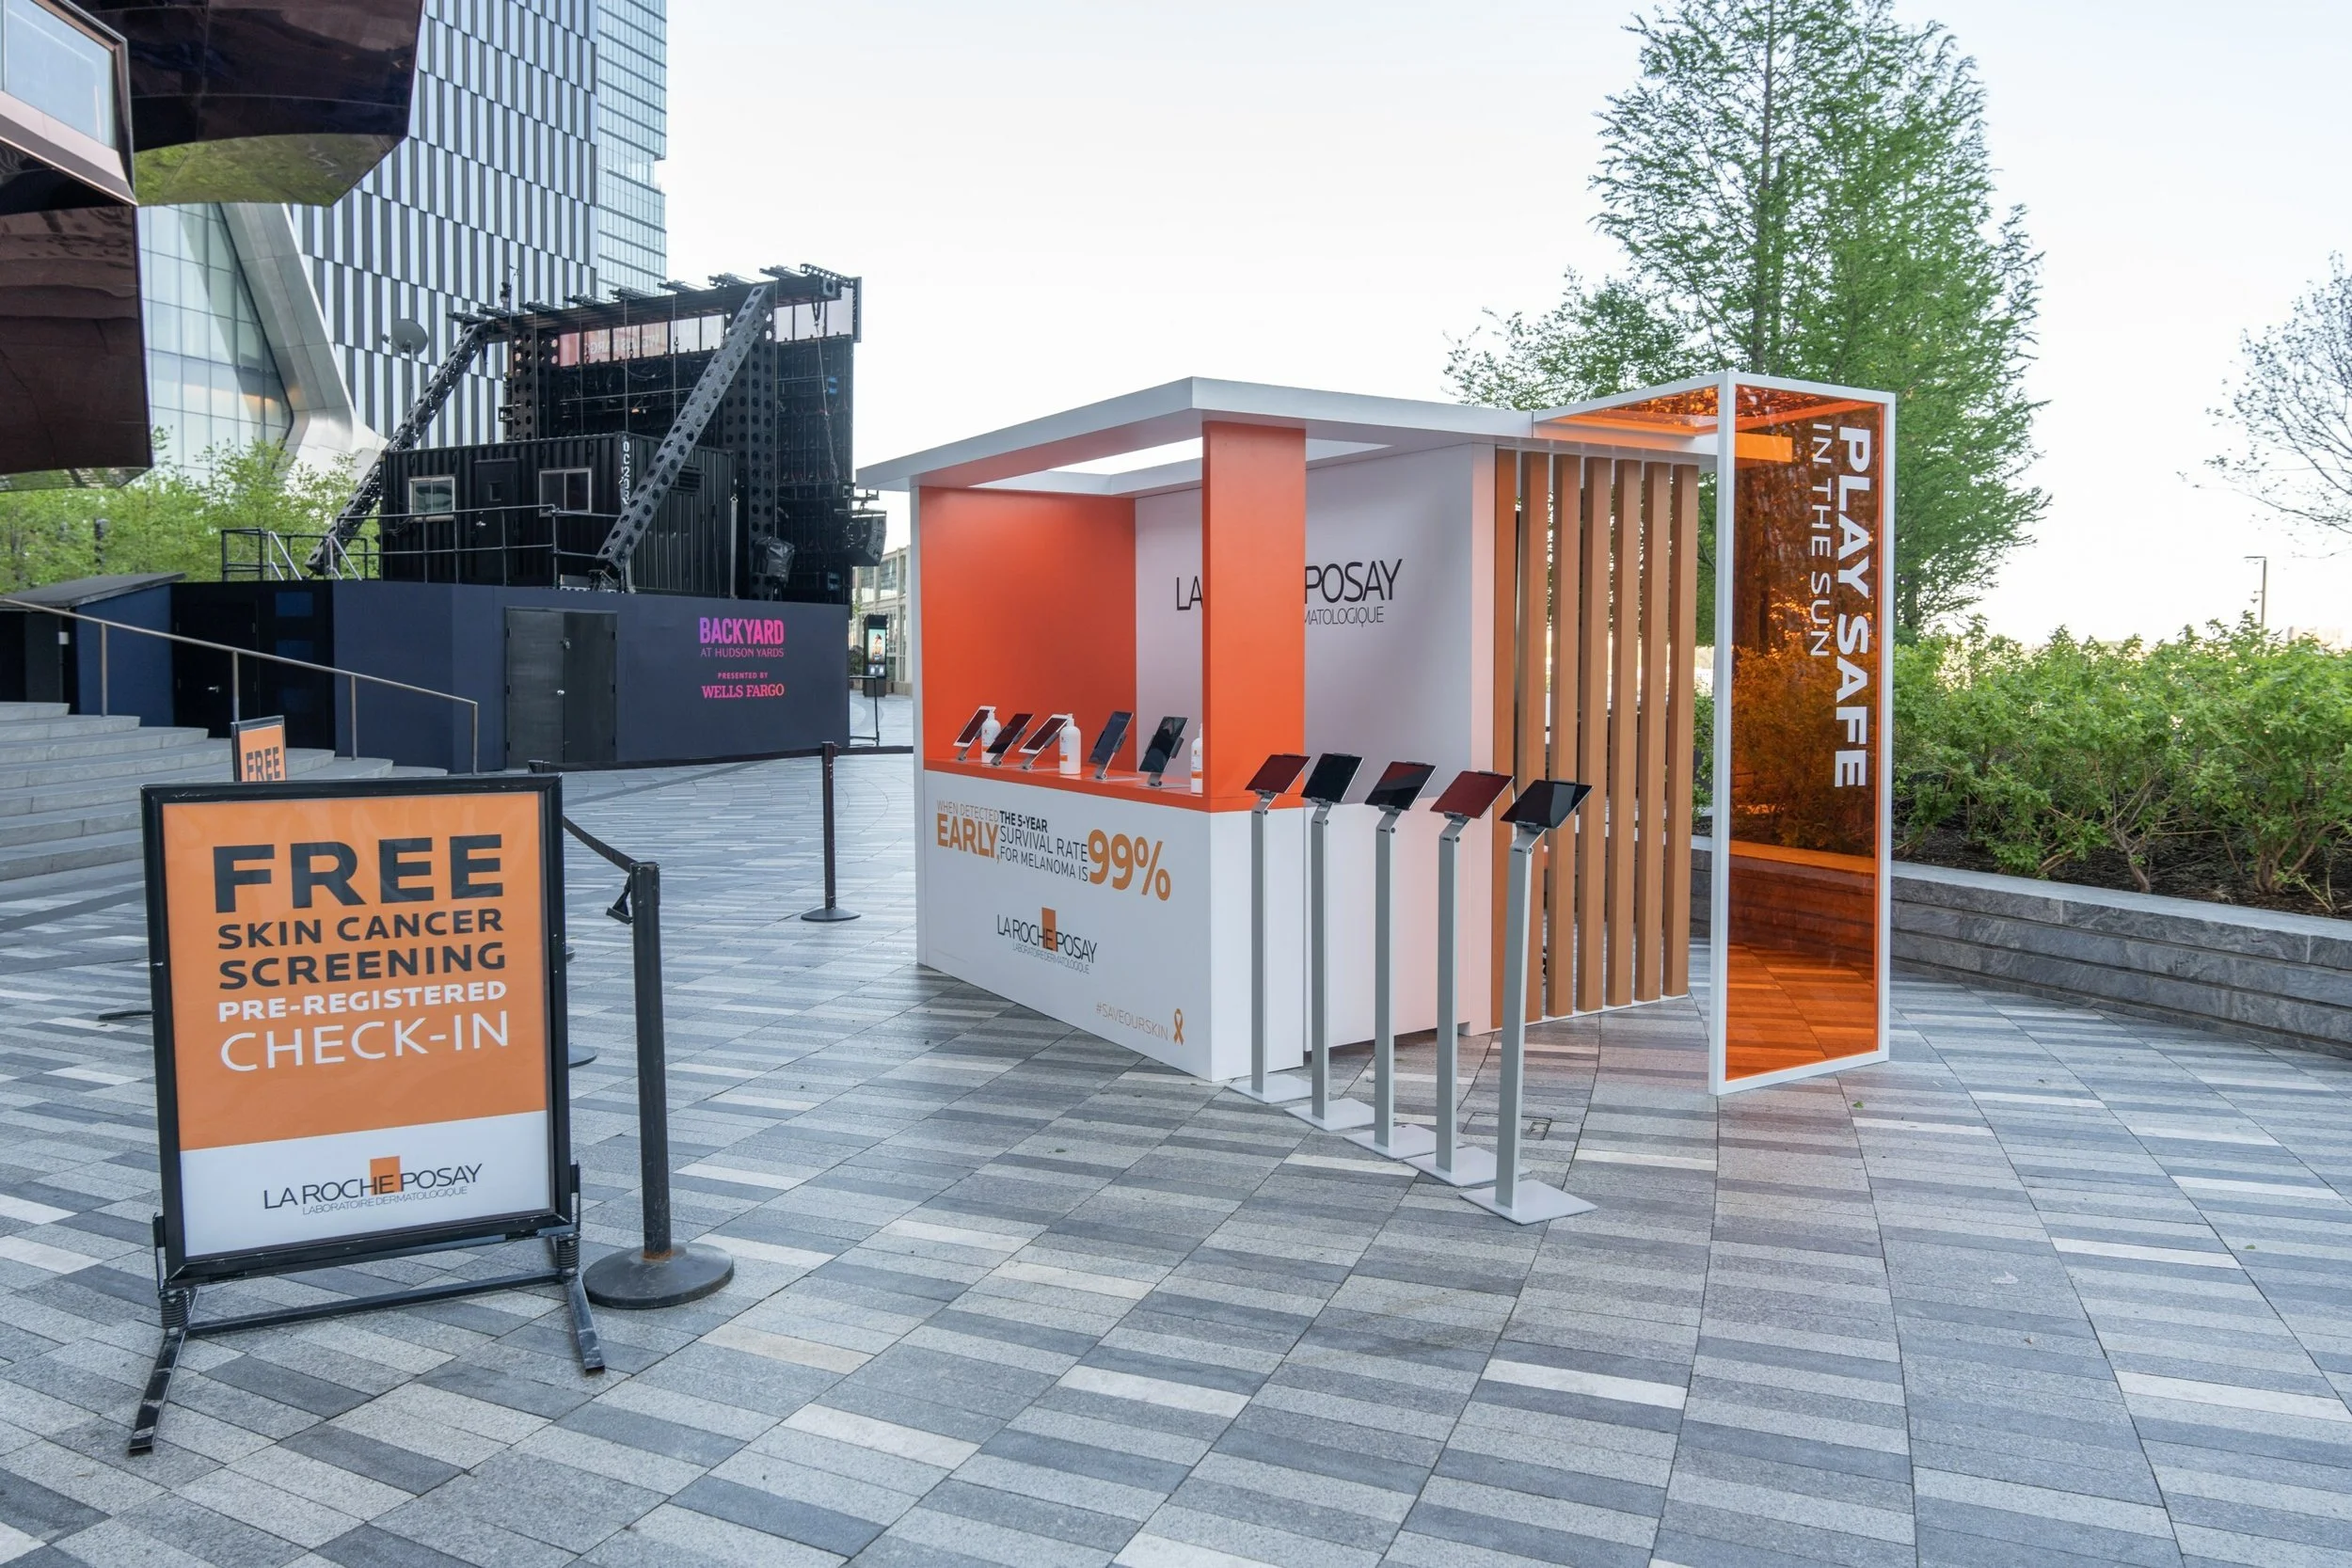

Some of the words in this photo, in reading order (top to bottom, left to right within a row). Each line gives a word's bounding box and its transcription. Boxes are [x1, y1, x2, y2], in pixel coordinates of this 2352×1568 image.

[1812, 423, 1832, 464] IN
[1811, 478, 1831, 557] THE
[1838, 427, 1870, 599] PLAY
[1176, 576, 1202, 610] LA
[1305, 559, 1403, 603] POSAY
[699, 617, 785, 644] BACKYARD
[1810, 571, 1830, 657] SUN
[700, 647, 712, 657] AT
[715, 647, 754, 657] HUDSON
[756, 647, 785, 657] YARDS
[701, 685, 743, 698] WELLS
[746, 684, 785, 697] FARGO
[1835, 613, 1868, 787] SAFE
[246, 746, 281, 782] FREE
[937, 800, 960, 816] WHEN
[960, 803, 999, 823] DETECTED
[999, 810, 1016, 826] THE
[1017, 815, 1048, 833] 5-YEAR
[937, 813, 1000, 863] EARLY,
[999, 825, 1054, 854] SURVIVAL
[1057, 838, 1088, 863] RATE
[213, 834, 503, 913] FREE
[1000, 846, 1019, 864] FOR
[1021, 851, 1076, 879] MELANOMA
[1078, 866, 1089, 881] IS
[1089, 830, 1171, 901] 99%
[217, 919, 322, 950] SKIN
[337, 908, 504, 942] CANCER
[996, 914, 1011, 938] LA
[1012, 919, 1055, 951] ROCHE
[1055, 931, 1097, 963] POSAY
[219, 942, 506, 990] SCREENING
[218, 980, 507, 1022] PRE-REGISTERED
[1096, 1002, 1168, 1041] #SAVEOURSKIN
[220, 1010, 509, 1072] CHECK-IN
[263, 1187, 298, 1210] LA
[302, 1174, 395, 1205] ROCHE
[400, 1164, 483, 1192] POSAY
[302, 1196, 374, 1215] LABORATOIRE
[375, 1186, 468, 1206] DERMATOLOGIQUE
